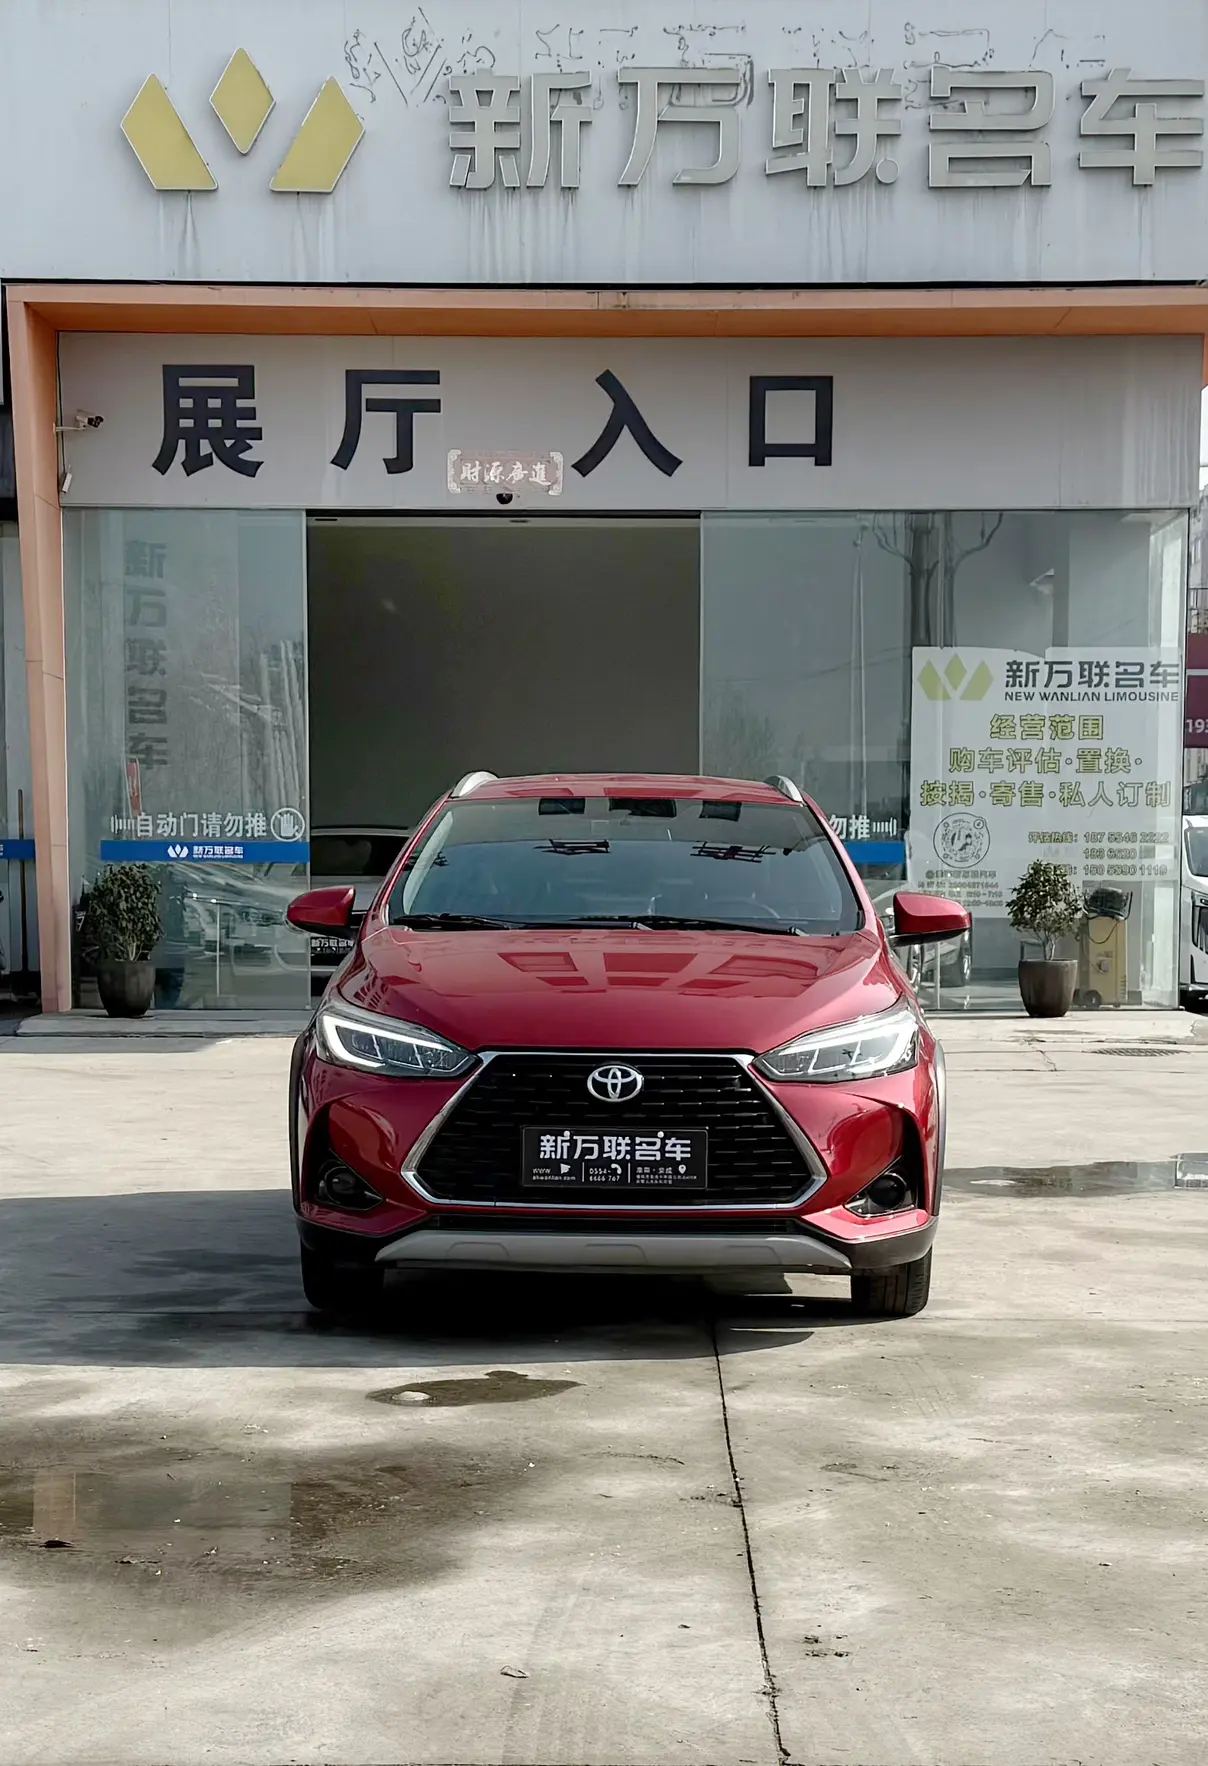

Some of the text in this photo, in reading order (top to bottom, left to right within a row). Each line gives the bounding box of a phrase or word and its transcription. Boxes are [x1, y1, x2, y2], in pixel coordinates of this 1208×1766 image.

[448, 66, 1204, 189] 新万联名车
[152, 364, 834, 477] 展厅入口
[1004, 660, 1180, 689] 新万联名车
[1004, 691, 1179, 702] NEW WANLIAN LIMOUSINE
[989, 713, 1104, 741] 经营范围
[137, 811, 268, 838] 自动门请勿推
[829, 814, 870, 840] 勿推
[539, 1134, 691, 1161] 新万联名车
